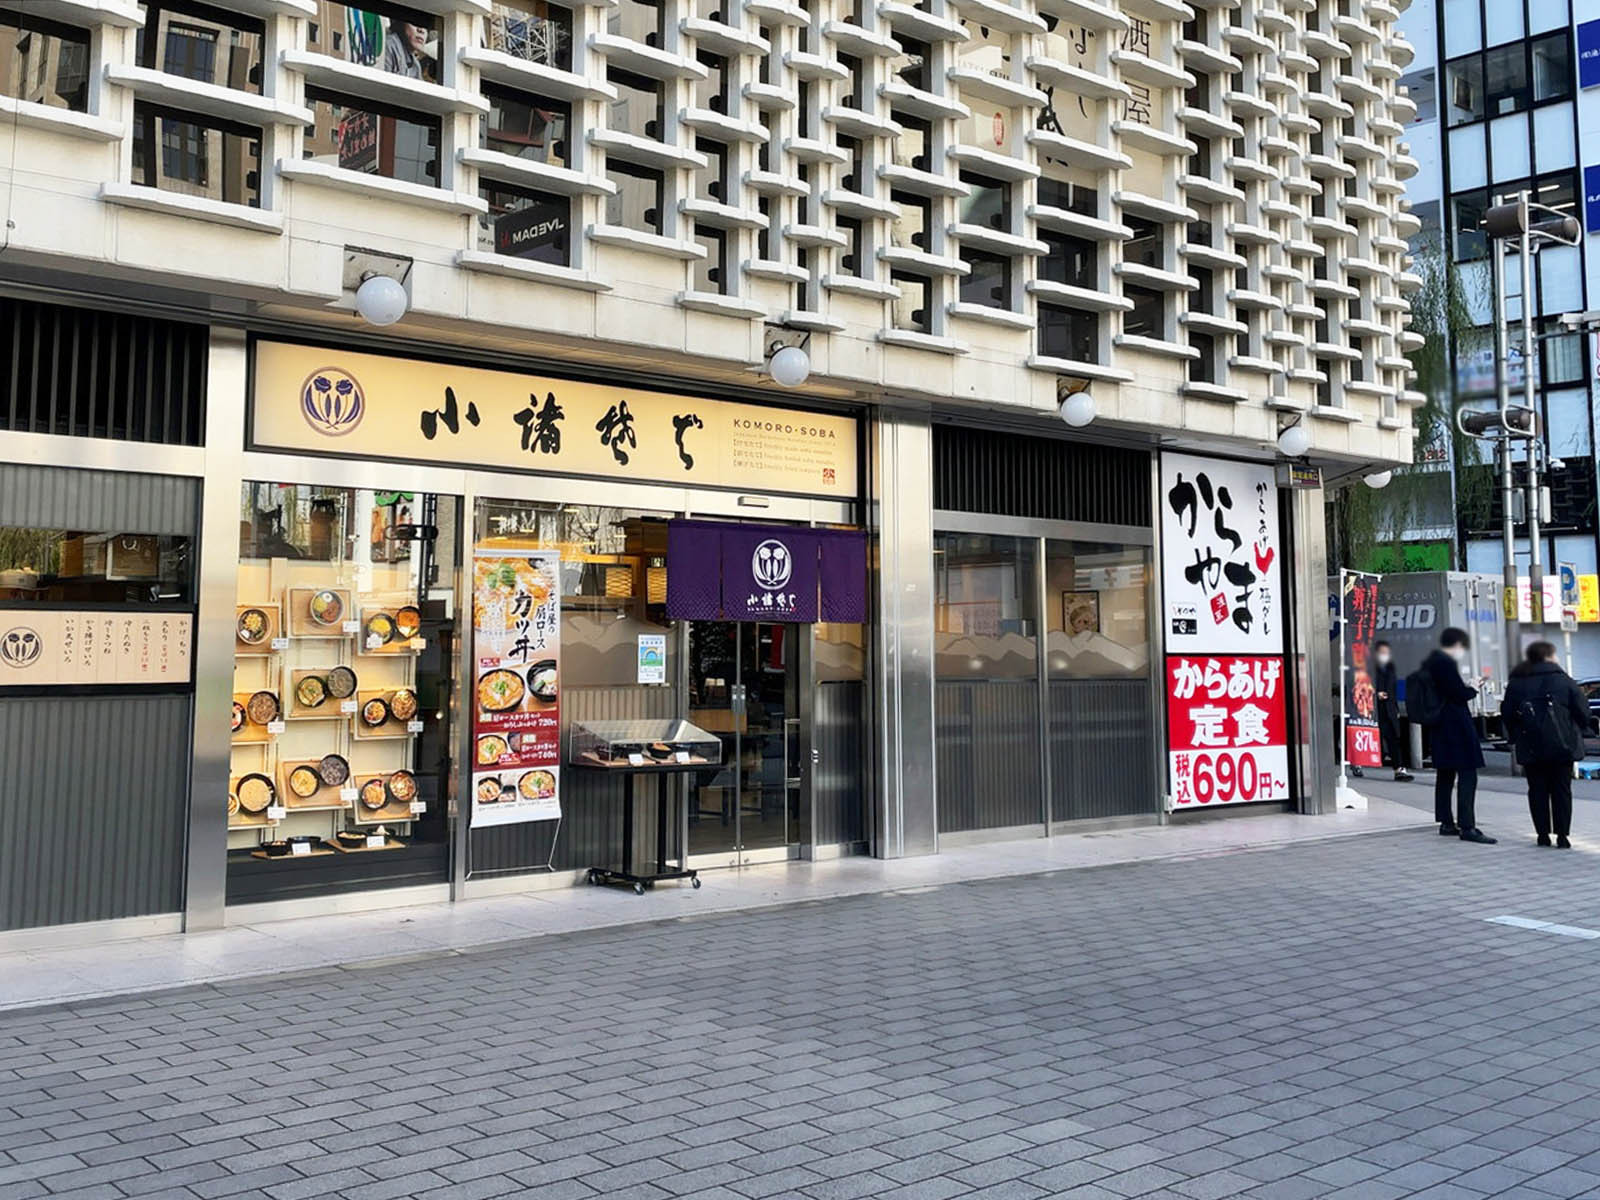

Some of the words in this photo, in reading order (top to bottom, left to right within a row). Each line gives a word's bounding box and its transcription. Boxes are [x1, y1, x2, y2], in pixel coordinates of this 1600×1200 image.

[1173, 658, 1281, 700] からあげ
[1188, 703, 1271, 748] 定食
[1175, 753, 1191, 804] 税込
